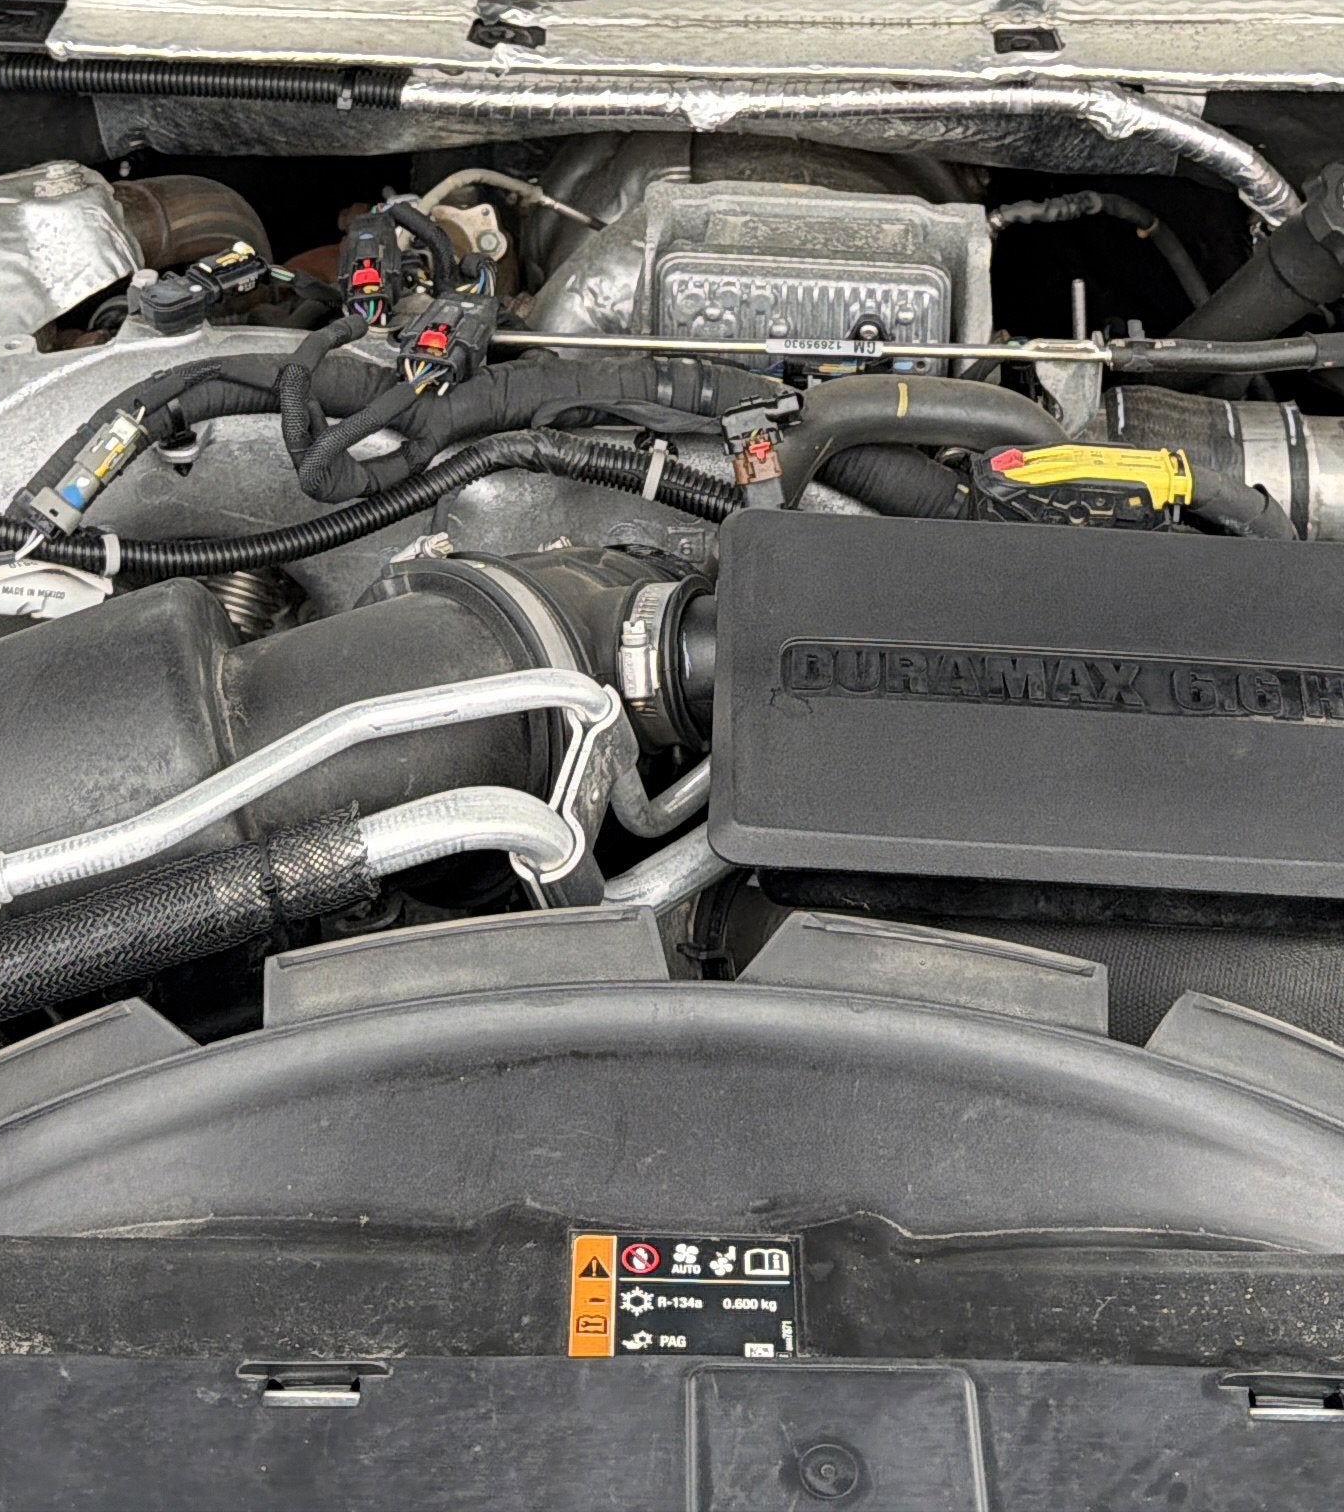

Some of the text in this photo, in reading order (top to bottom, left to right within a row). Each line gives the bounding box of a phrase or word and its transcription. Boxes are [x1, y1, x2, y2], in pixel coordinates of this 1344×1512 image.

[784, 339, 876, 354] GM 12695930
[2, 586, 66, 600] MADE IN MEXICO
[789, 646, 1145, 707] DURAMAX
[1173, 668, 1283, 717] 6.6
[671, 1264, 701, 1275] AUTO
[657, 1297, 778, 1313] R-134a 0.600 kg
[660, 1335, 687, 1348] PAG
